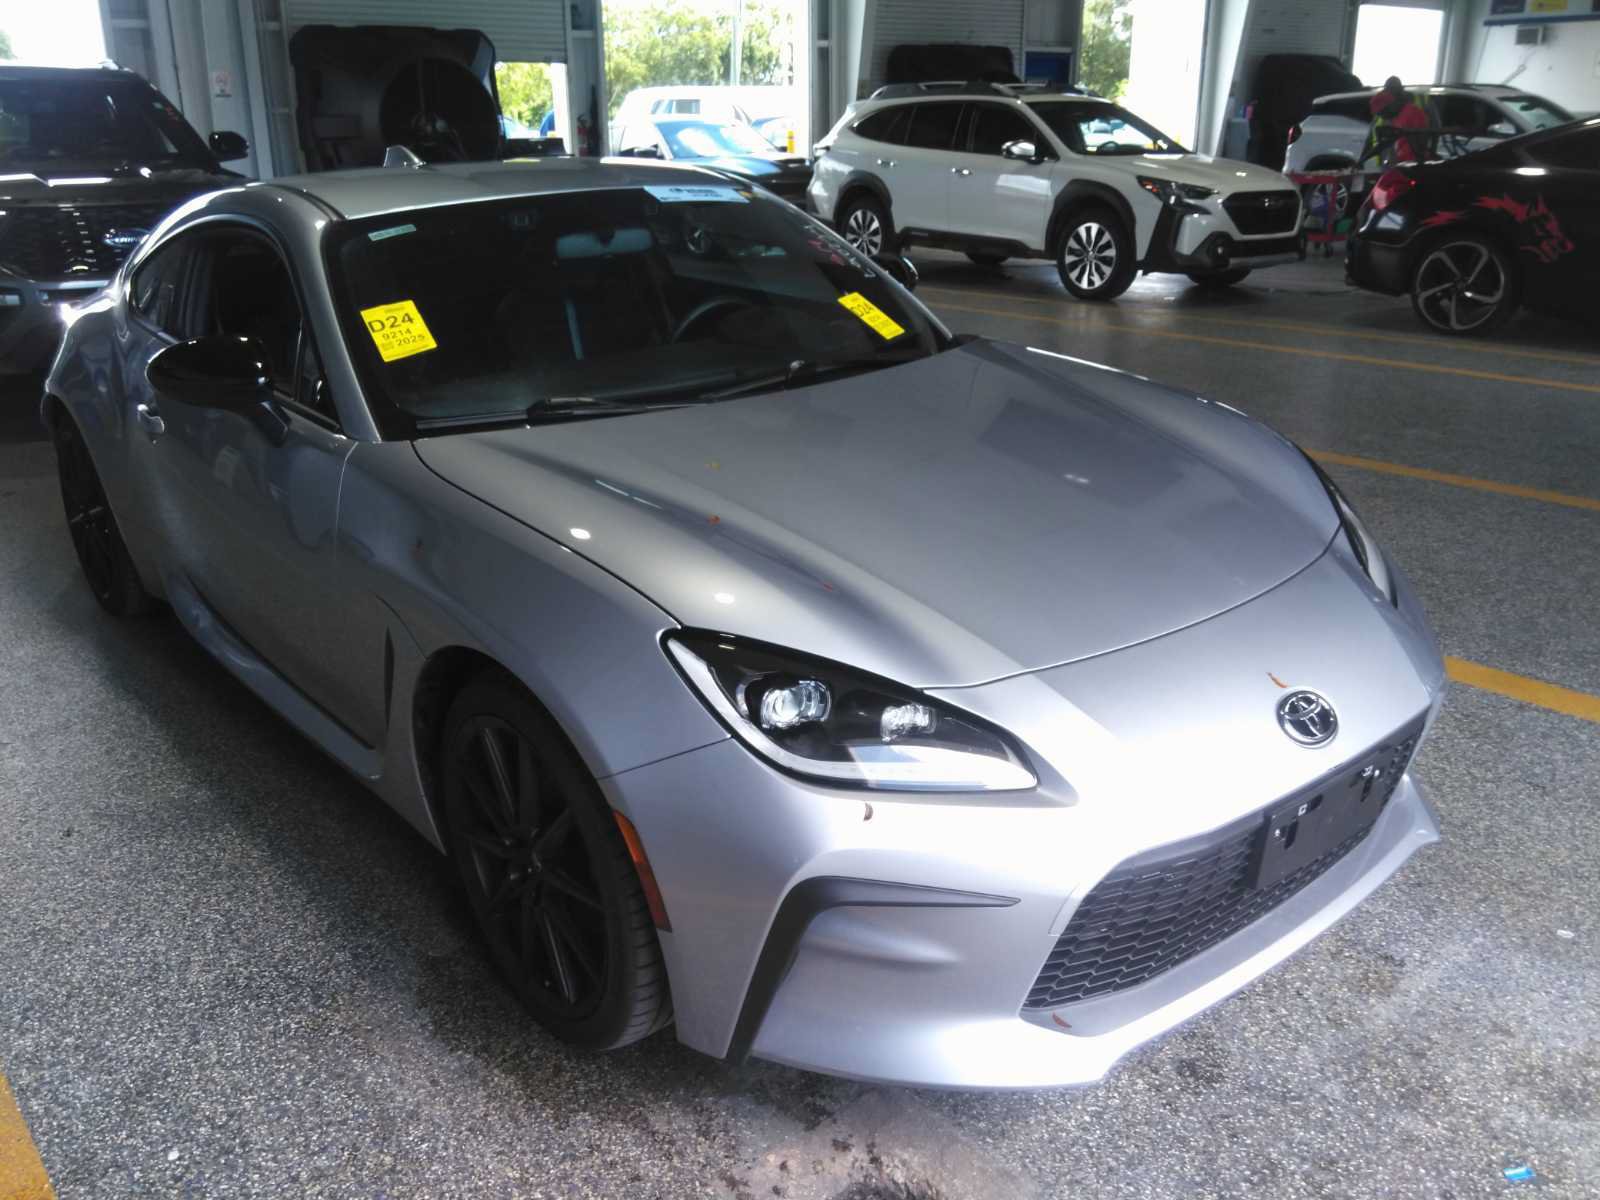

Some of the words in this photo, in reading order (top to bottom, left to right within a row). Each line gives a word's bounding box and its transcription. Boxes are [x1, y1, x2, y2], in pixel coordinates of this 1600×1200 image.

[368, 312, 414, 333] D24
[382, 328, 412, 340] 9214
[395, 334, 425, 346] 2025
